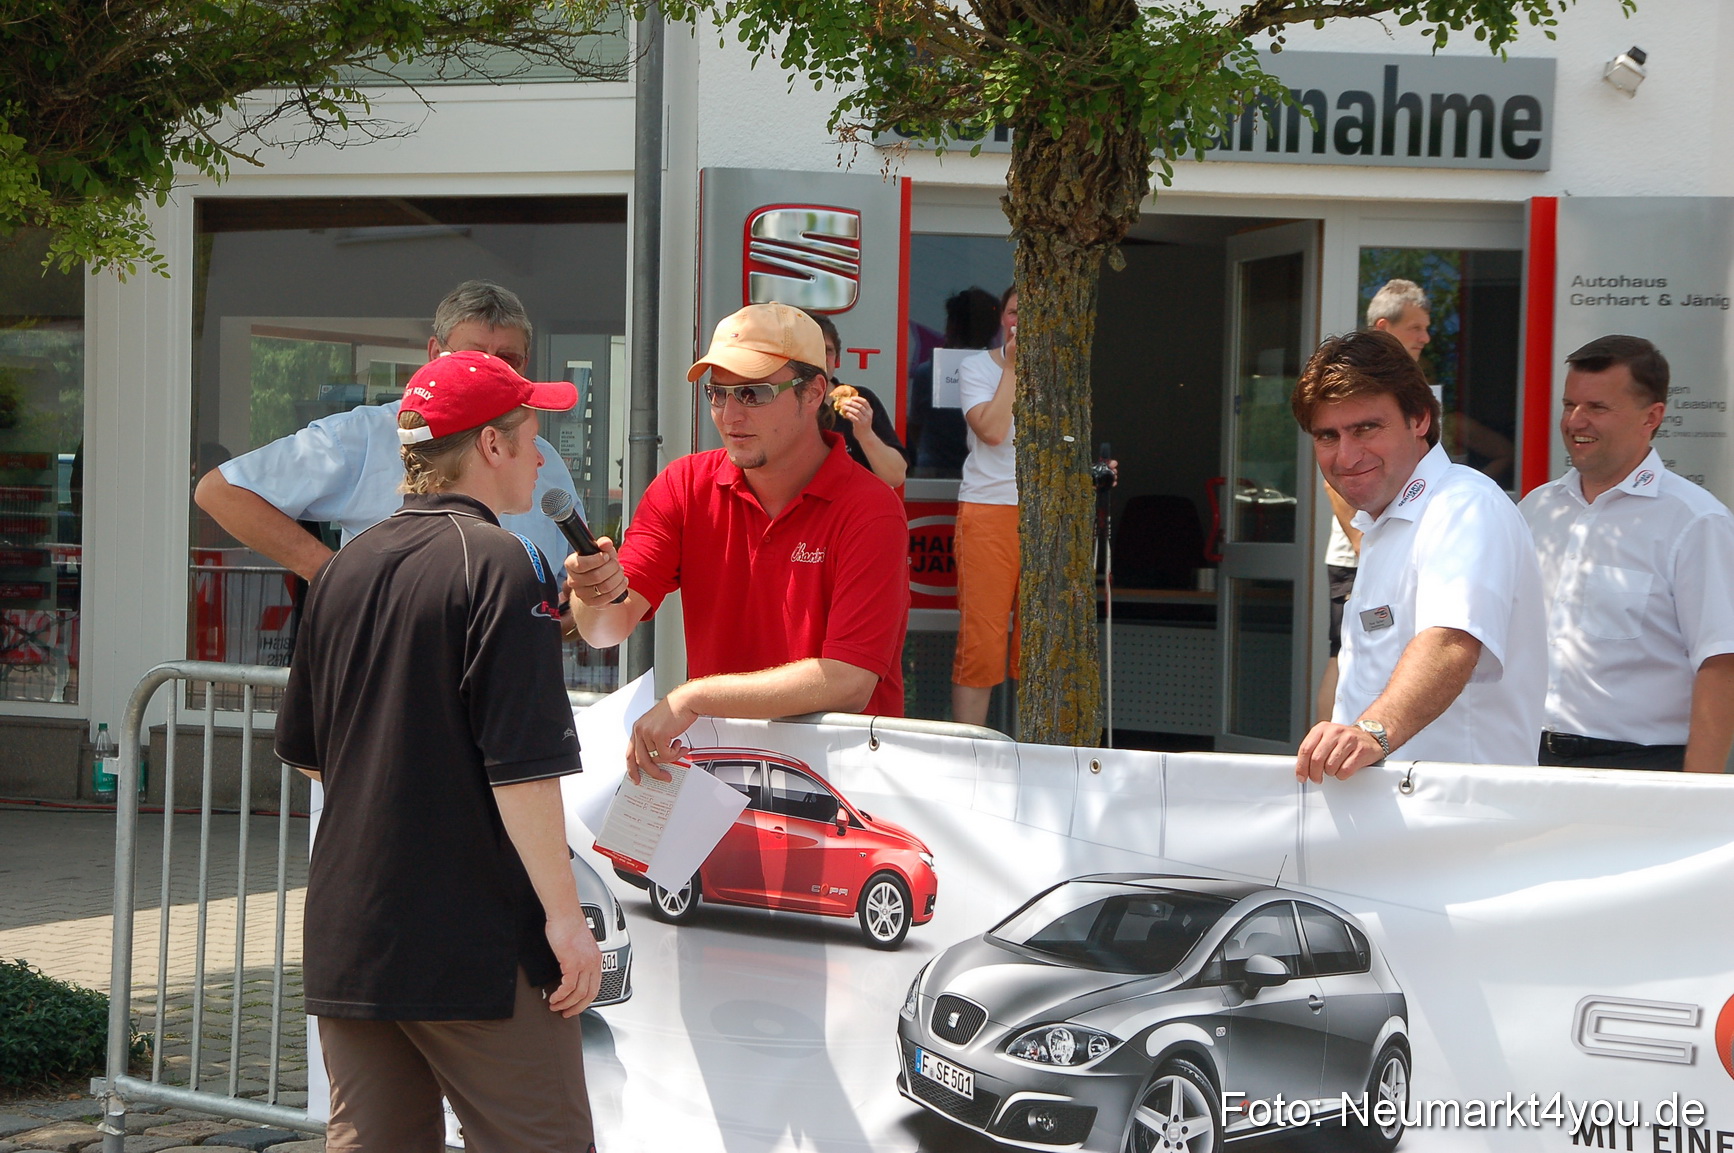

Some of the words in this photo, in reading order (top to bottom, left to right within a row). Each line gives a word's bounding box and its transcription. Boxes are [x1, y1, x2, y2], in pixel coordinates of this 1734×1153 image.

[1571, 275, 1668, 288] Autohaus
[1570, 293, 1650, 307] Gerhart
[1657, 294, 1673, 306] &
[1680, 293, 1731, 311] Jänig
[413, 386, 435, 401] KELLY
[1674, 400, 1727, 412] Leasing
[602, 954, 616, 970] 601
[922, 1054, 929, 1073] F
